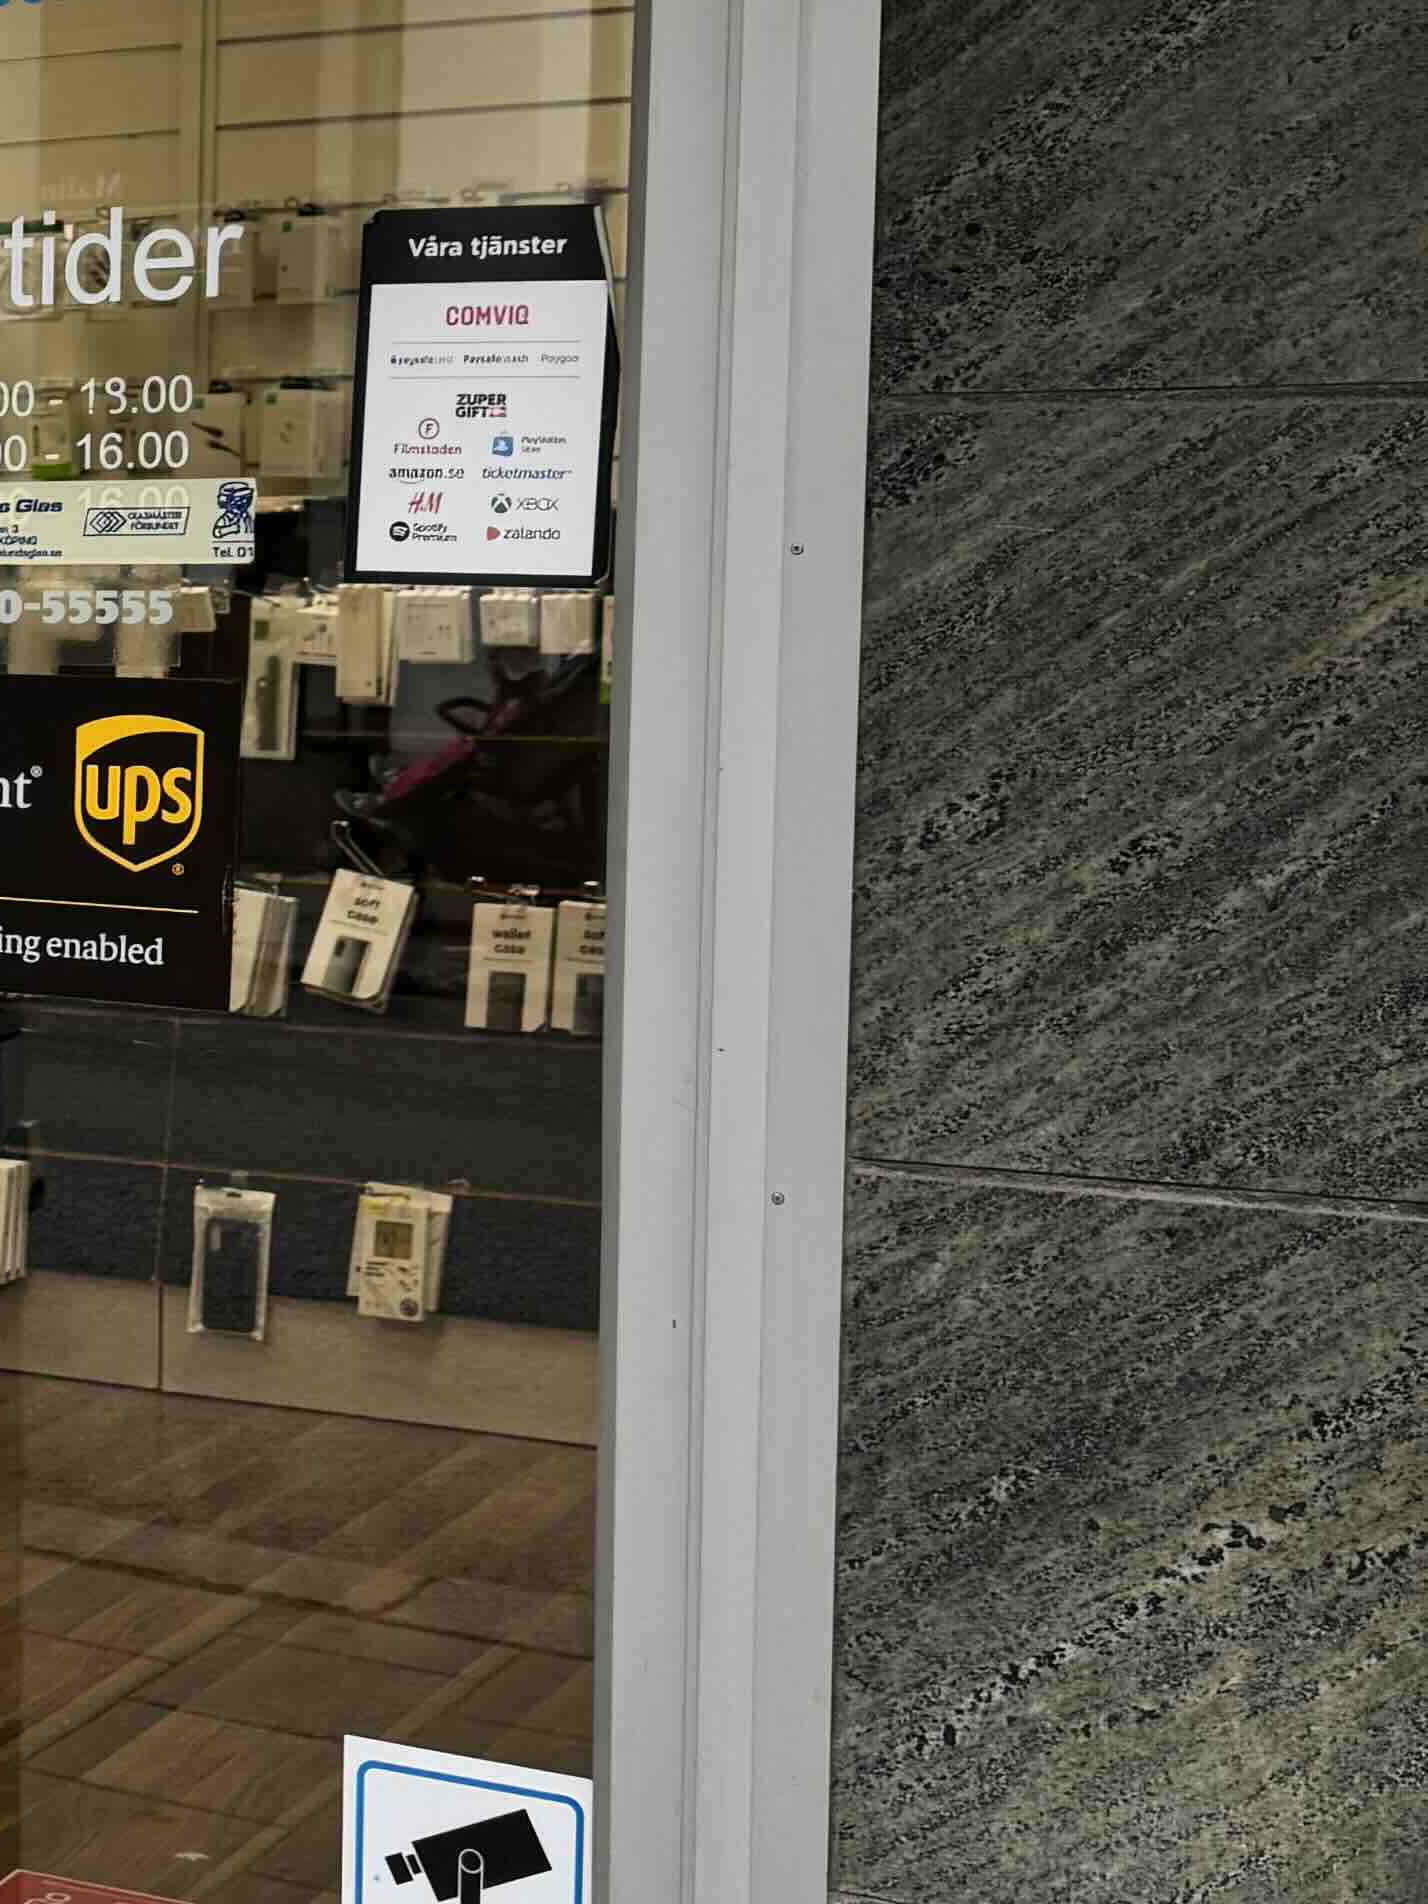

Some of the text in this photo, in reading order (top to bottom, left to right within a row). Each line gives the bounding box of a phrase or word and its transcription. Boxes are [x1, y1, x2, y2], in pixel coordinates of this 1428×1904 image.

[408, 235, 568, 261] Våra tjänster
[445, 303, 530, 327] COMVIQ
[455, 393, 507, 405] ZUPER
[455, 406, 489, 418] GIFT
[75, 429, 190, 470] 16.00
[393, 443, 462, 456] Filmstaden
[389, 466, 465, 481] amazon.se
[482, 466, 565, 481] ticketmaster
[503, 525, 561, 541] zalando
[85, 762, 192, 846] ups
[346, 910, 379, 924] case
[46, 931, 164, 966] enabled
[494, 943, 526, 954] case
